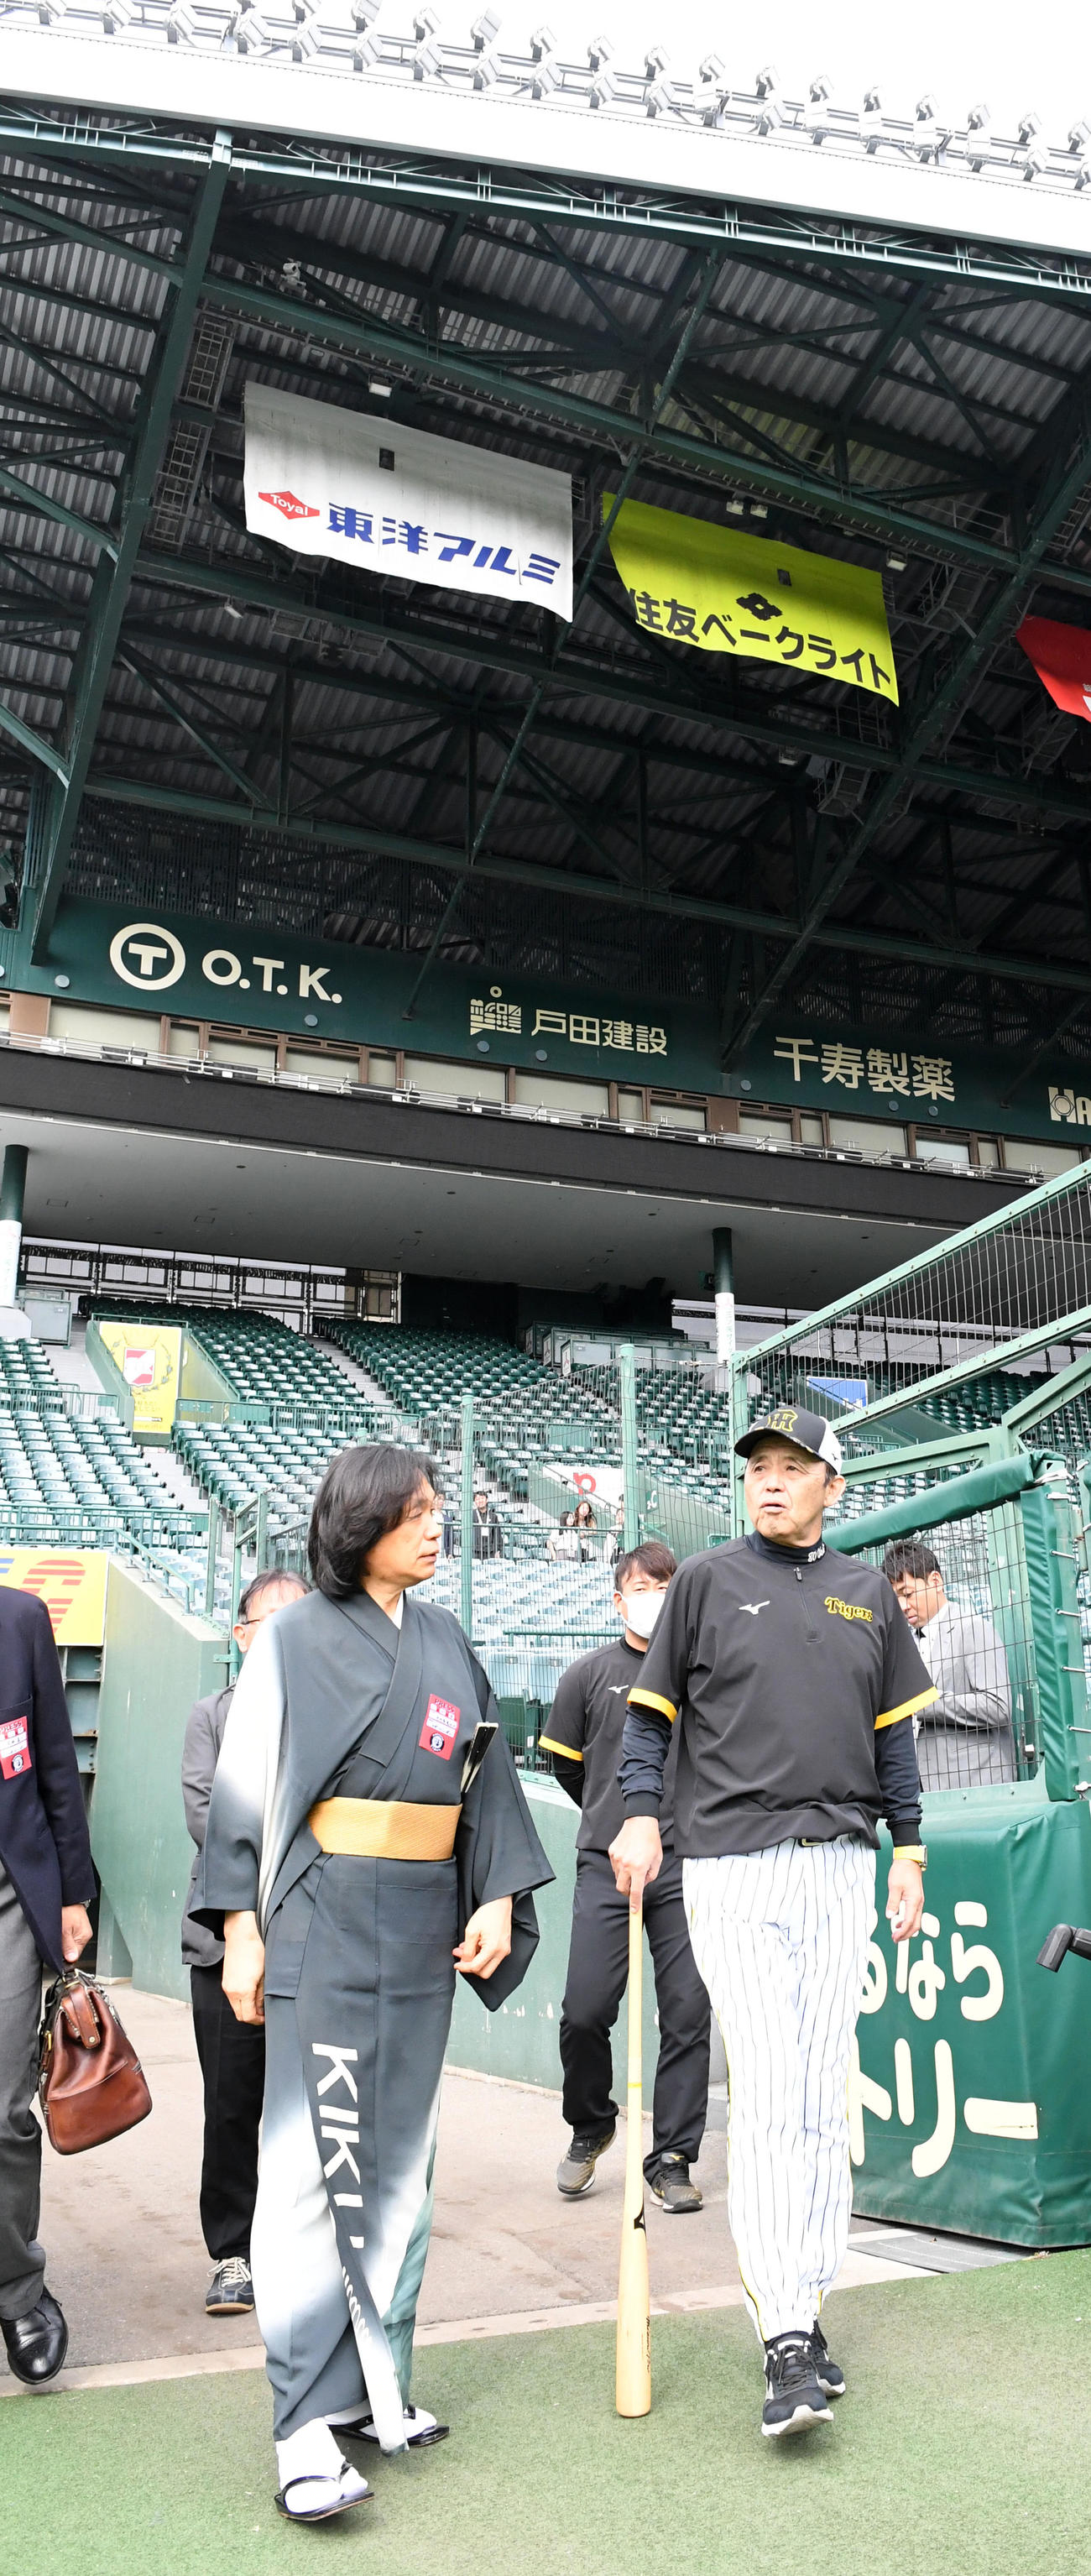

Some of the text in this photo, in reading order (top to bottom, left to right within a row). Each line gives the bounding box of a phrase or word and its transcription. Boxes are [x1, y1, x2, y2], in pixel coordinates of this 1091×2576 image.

[270, 494, 308, 516] Toyal
[326, 502, 561, 585] 東洋アルミ
[629, 588, 891, 689] 住友ベークライト
[202, 949, 343, 1004] O.T.K.
[530, 1008, 668, 1057] 戸田建設
[773, 1037, 957, 1102] 千寿製薬
[824, 1596, 874, 1622] Tigers
